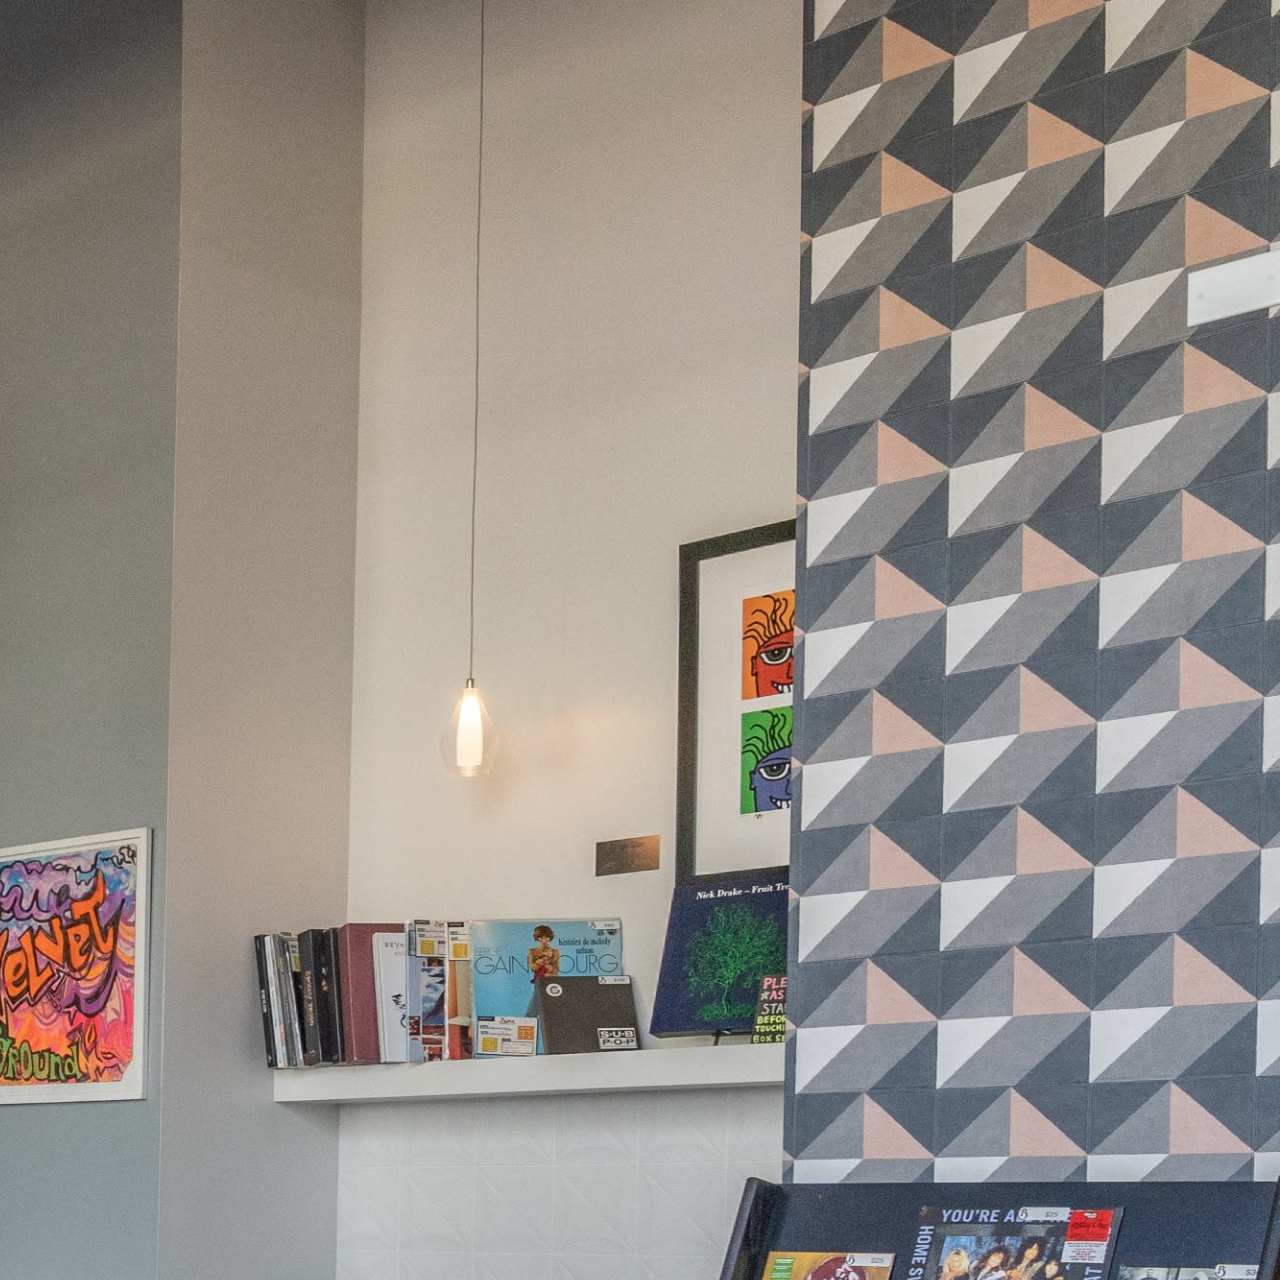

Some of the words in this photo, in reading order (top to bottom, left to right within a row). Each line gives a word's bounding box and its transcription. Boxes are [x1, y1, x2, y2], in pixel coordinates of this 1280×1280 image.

[696, 891, 715, 900] Nick
[717, 888, 742, 898] Drake
[752, 884, 773, 894] Fruit
[775, 882, 790, 891] Tre
[763, 977, 788, 989] PLE
[770, 990, 784, 1000] AS
[761, 1003, 784, 1014] STA
[941, 1209, 1000, 1222] YOU'RE
[916, 1225, 935, 1265] HOME
